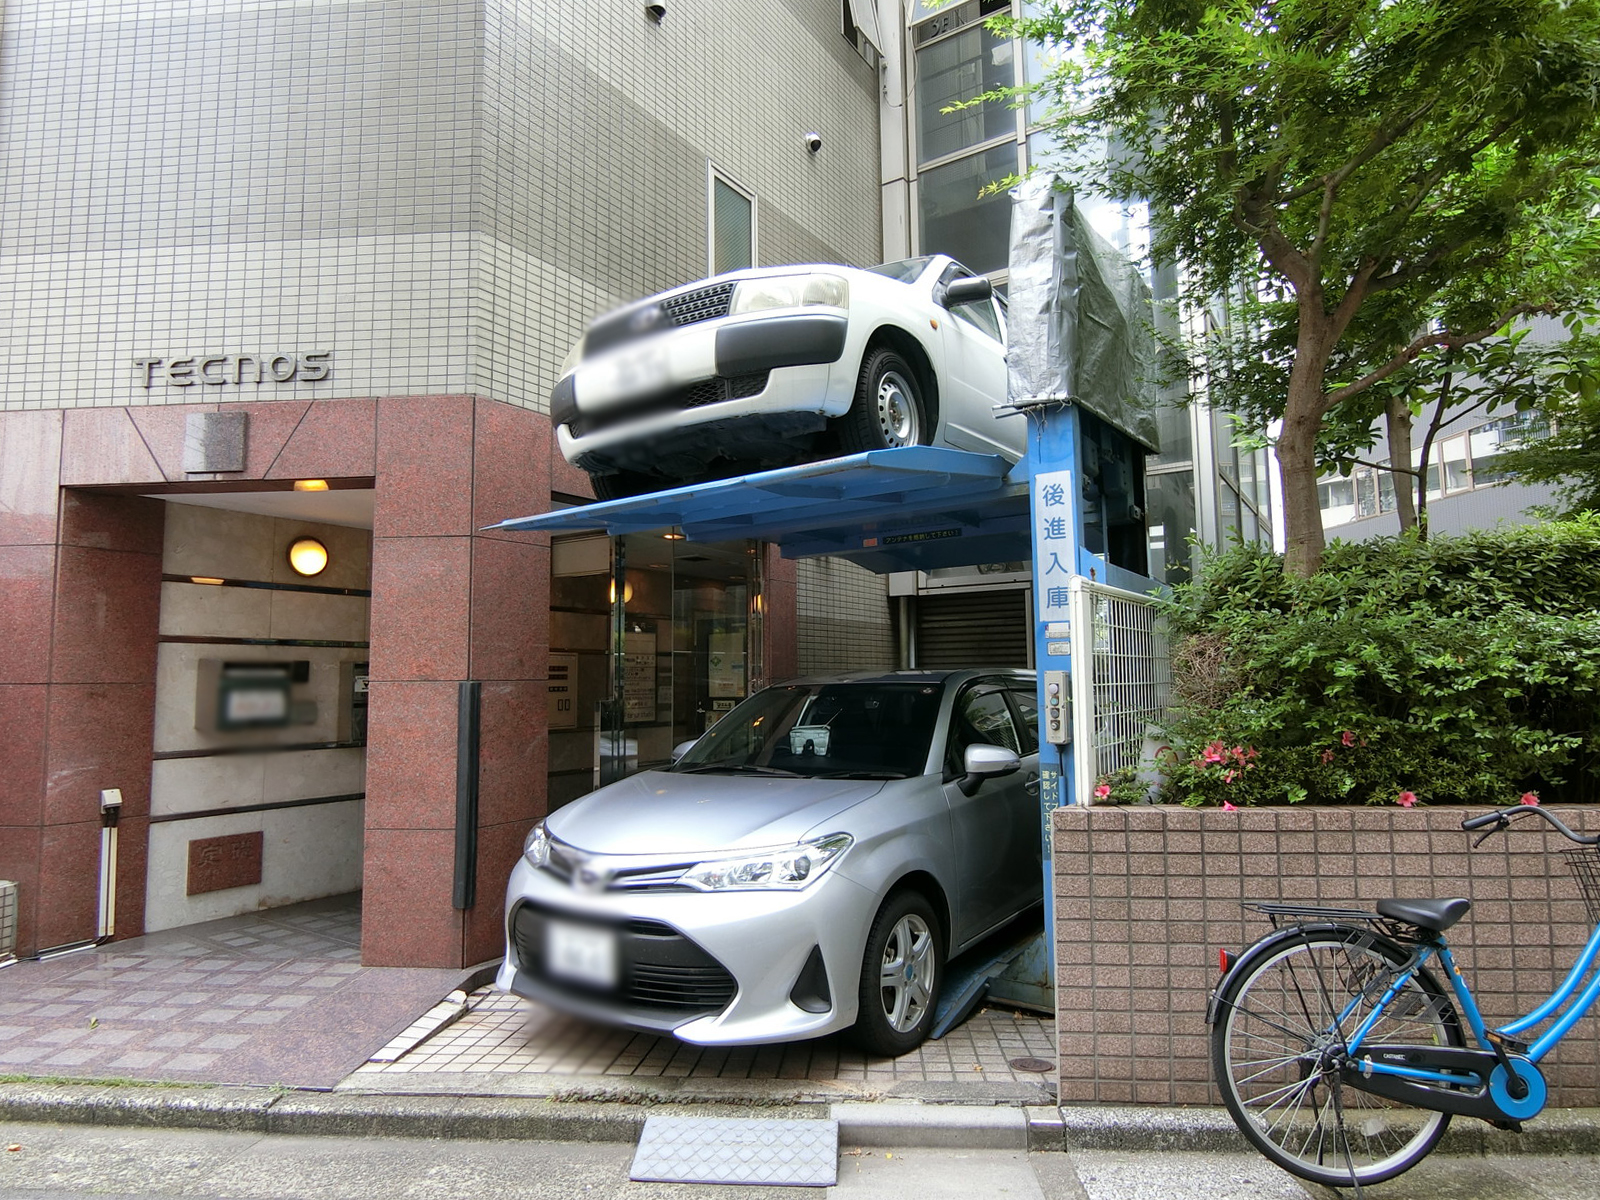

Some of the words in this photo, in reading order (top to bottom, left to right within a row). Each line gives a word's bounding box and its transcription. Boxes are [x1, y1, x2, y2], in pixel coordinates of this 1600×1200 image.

[134, 349, 330, 389] TECNOS
[1042, 483, 1069, 609] 後進入庫
